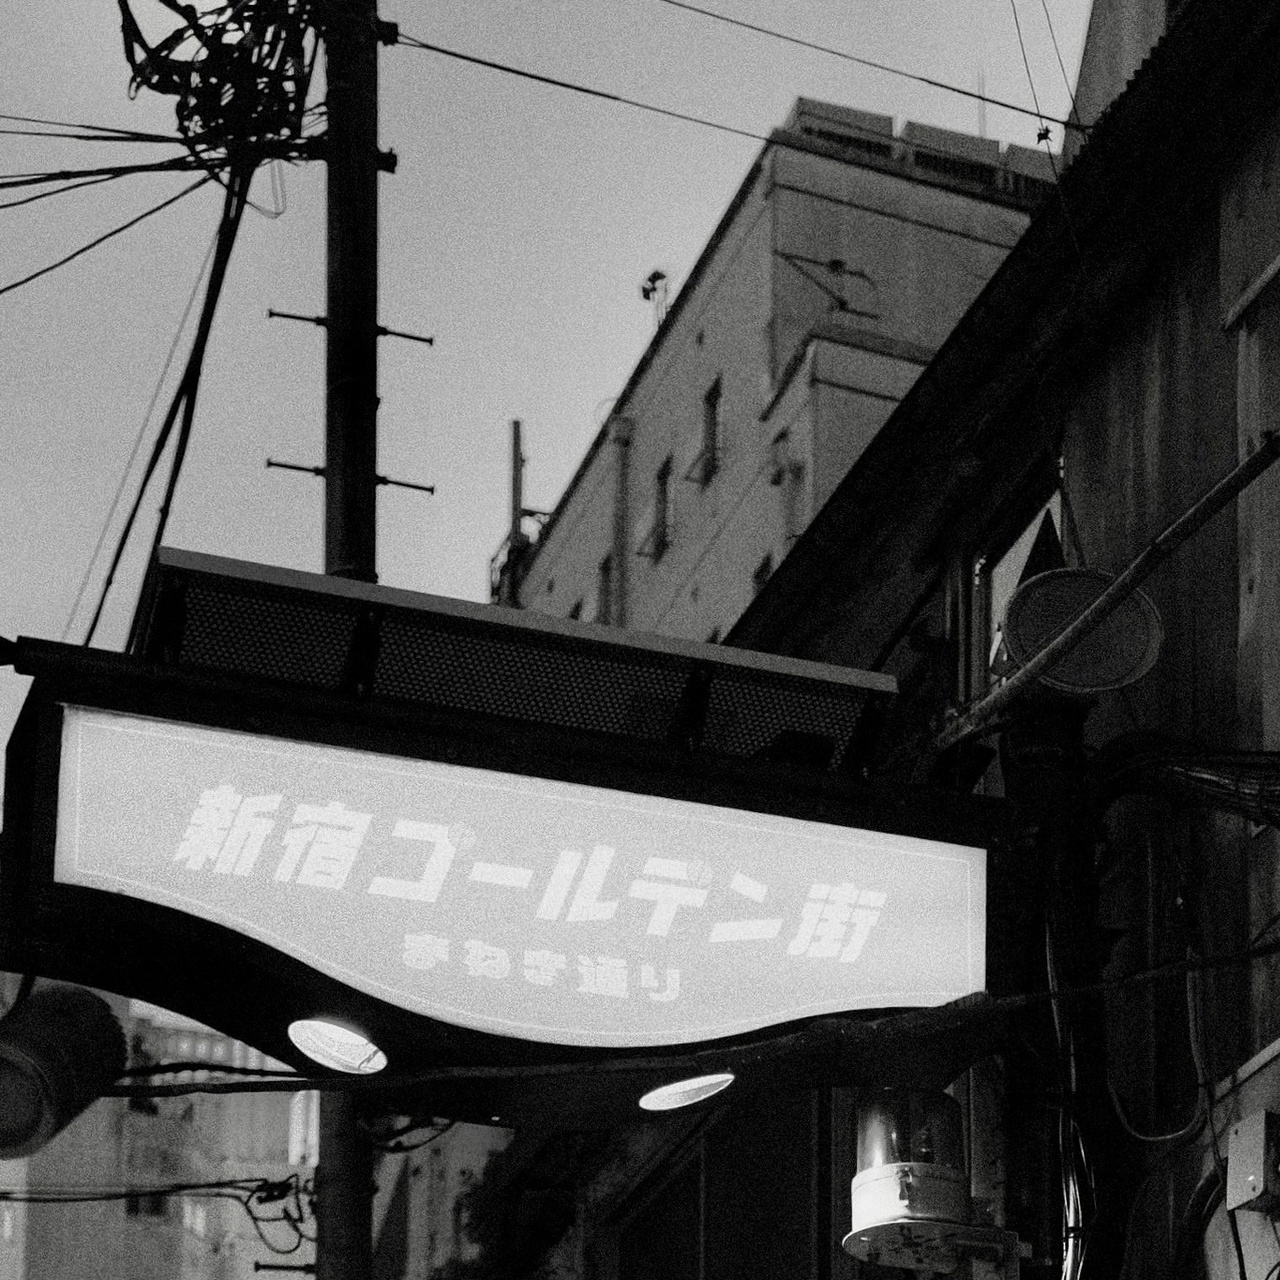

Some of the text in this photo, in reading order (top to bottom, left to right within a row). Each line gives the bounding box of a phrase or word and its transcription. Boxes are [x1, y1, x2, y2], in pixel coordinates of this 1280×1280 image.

[173, 783, 888, 964] 新宿ゴールデン街
